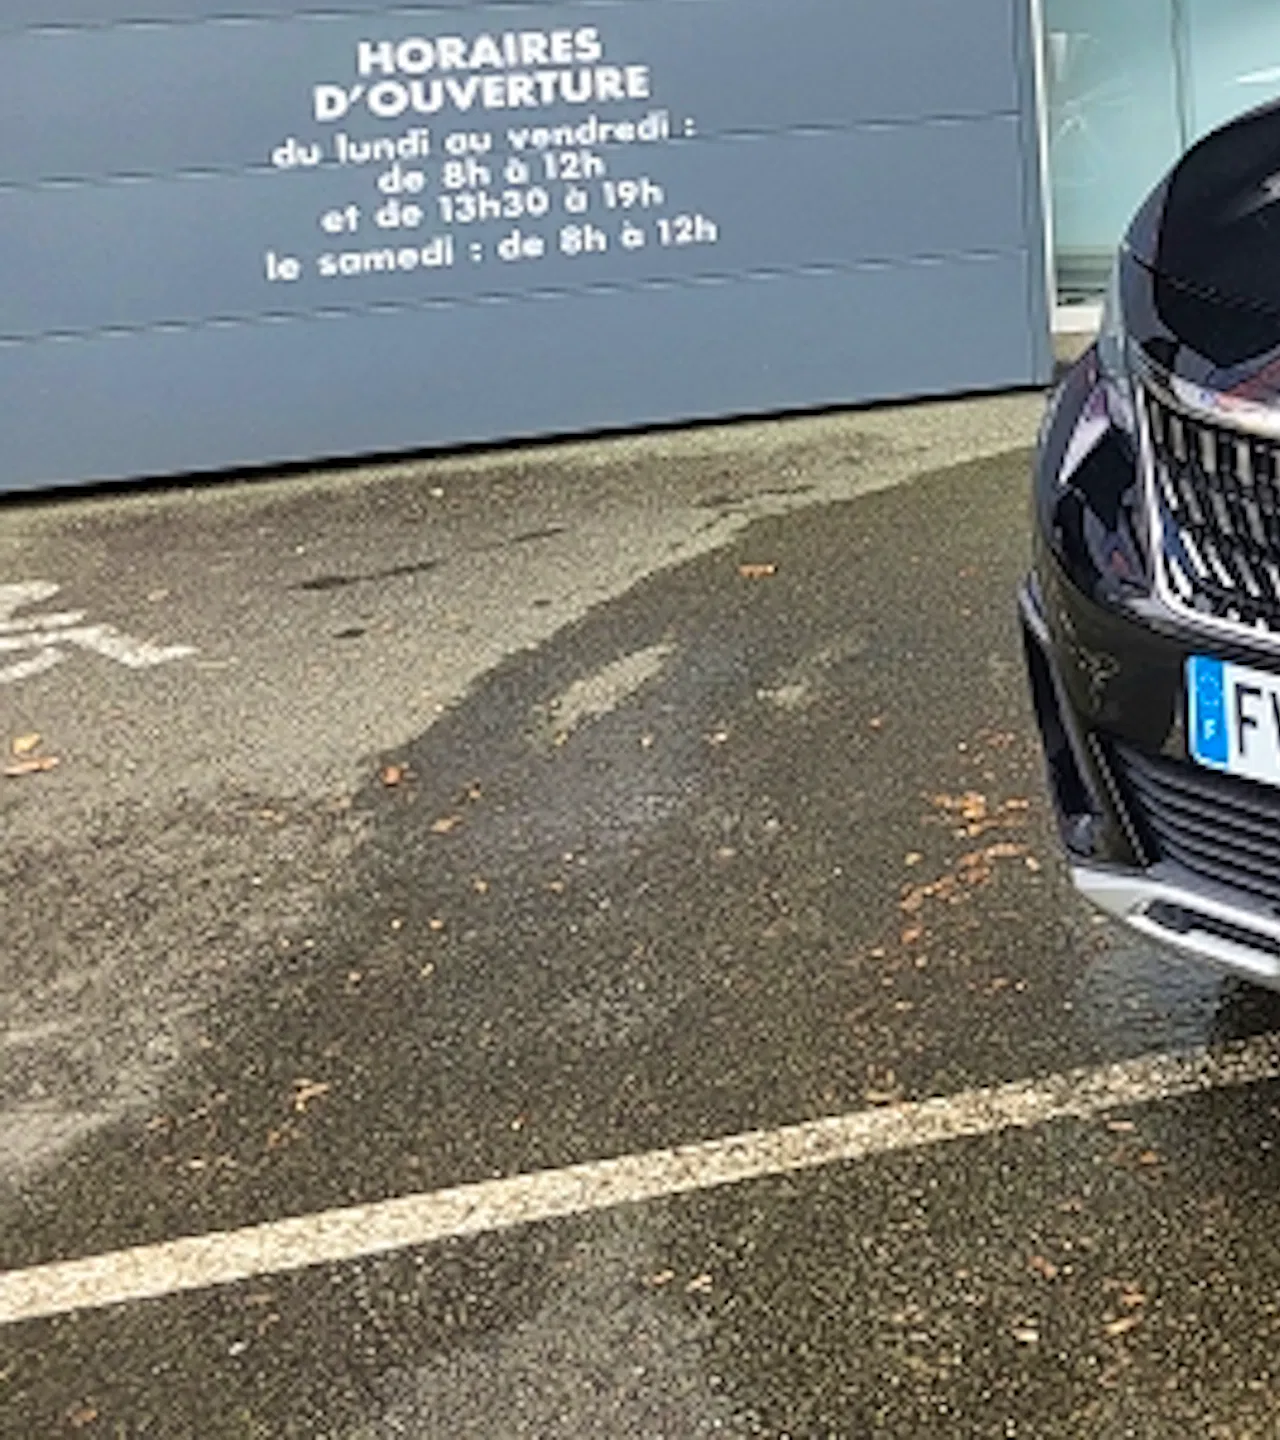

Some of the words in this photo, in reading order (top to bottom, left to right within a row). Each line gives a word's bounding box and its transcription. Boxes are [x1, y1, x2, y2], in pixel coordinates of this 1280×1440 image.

[357, 28, 603, 75] HORAIRES
[314, 66, 650, 121] D'OUVERTURE
[271, 138, 320, 168] du
[336, 128, 430, 163] lundi
[445, 131, 492, 155] au
[507, 110, 669, 151] vendredi
[378, 165, 426, 195] de
[443, 161, 490, 190] 8h
[505, 157, 530, 184] à
[544, 151, 606, 180] 12h
[320, 205, 359, 233] et
[375, 198, 424, 229] de
[439, 187, 549, 224] 13h30
[564, 185, 589, 213] à
[603, 178, 665, 210] 19h
[265, 251, 300, 281] le
[318, 236, 453, 277] samedi
[497, 229, 545, 261] de
[559, 225, 606, 254] 8h
[620, 220, 645, 248] à
[656, 213, 718, 245] 12h
